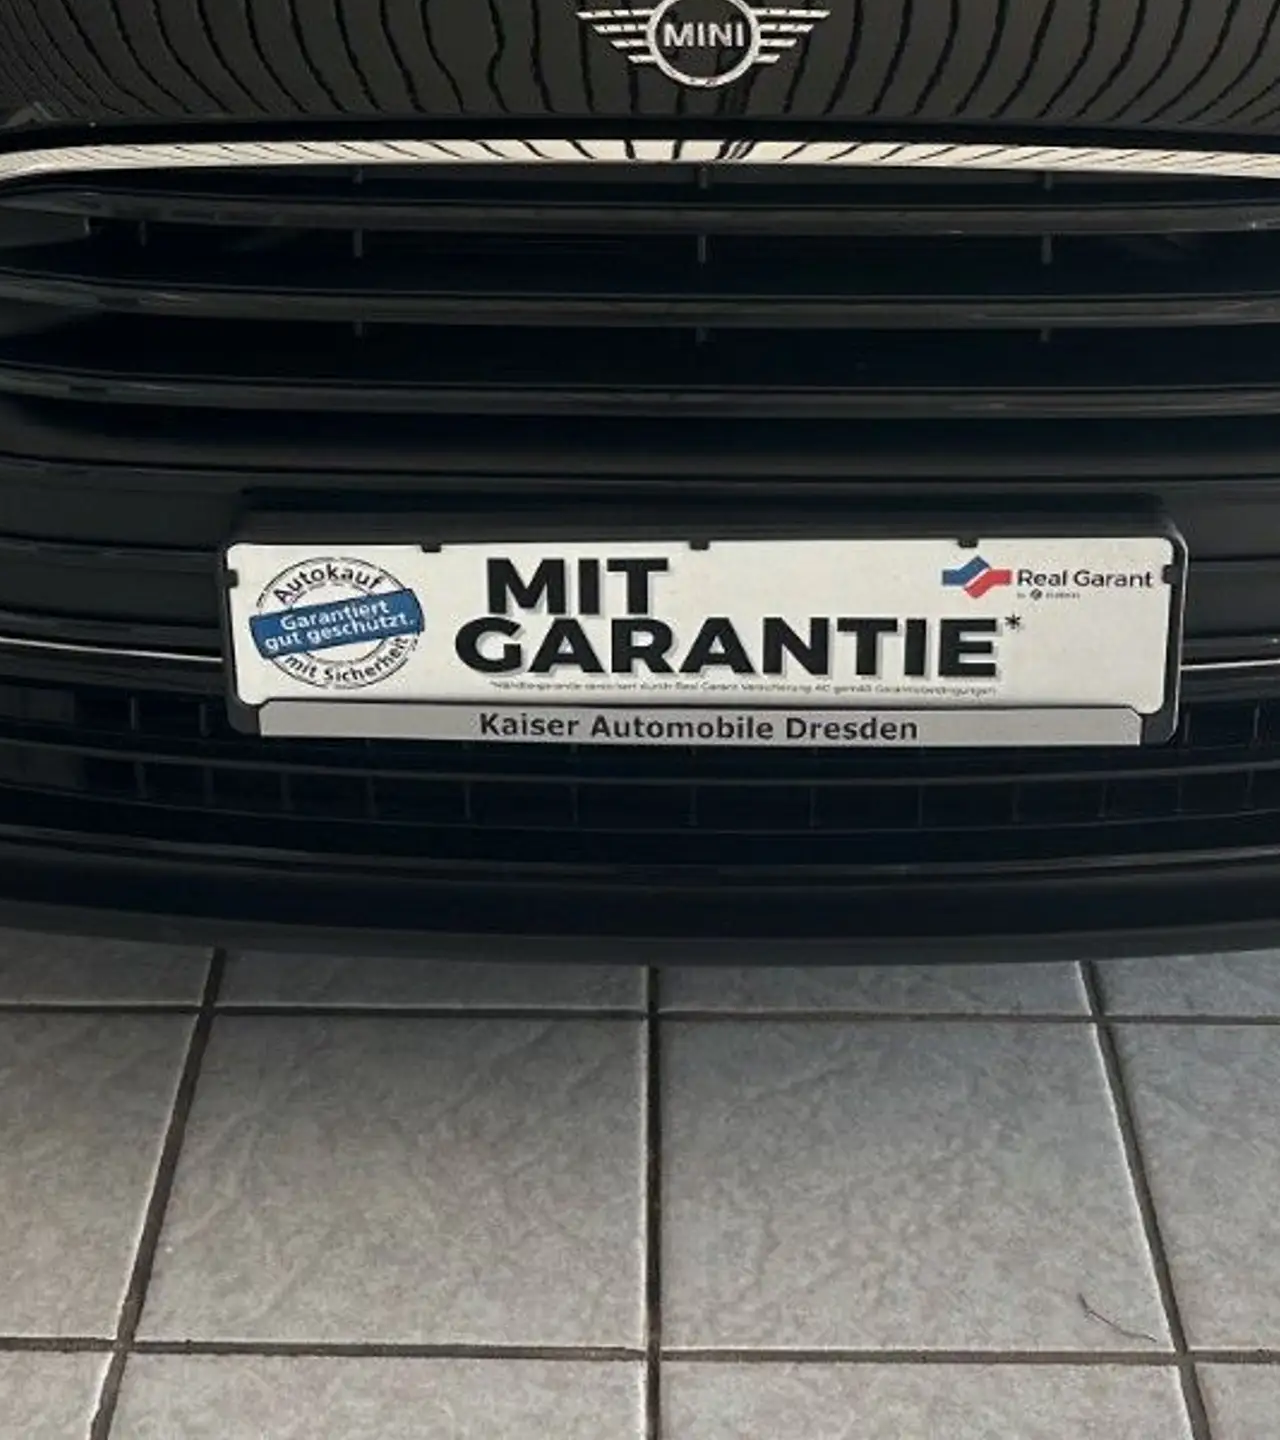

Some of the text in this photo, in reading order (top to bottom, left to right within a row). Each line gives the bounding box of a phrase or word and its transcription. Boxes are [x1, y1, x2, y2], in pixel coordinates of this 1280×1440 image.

[663, 22, 745, 47] MINI
[273, 563, 383, 605] Autokauf
[486, 557, 669, 615] MIT
[1016, 569, 1154, 588] Real Garant
[279, 599, 391, 631] Garantiert
[265, 633, 303, 651] gut
[284, 654, 317, 678] mit
[479, 712, 919, 740] Kaiser Automobile Dresden
